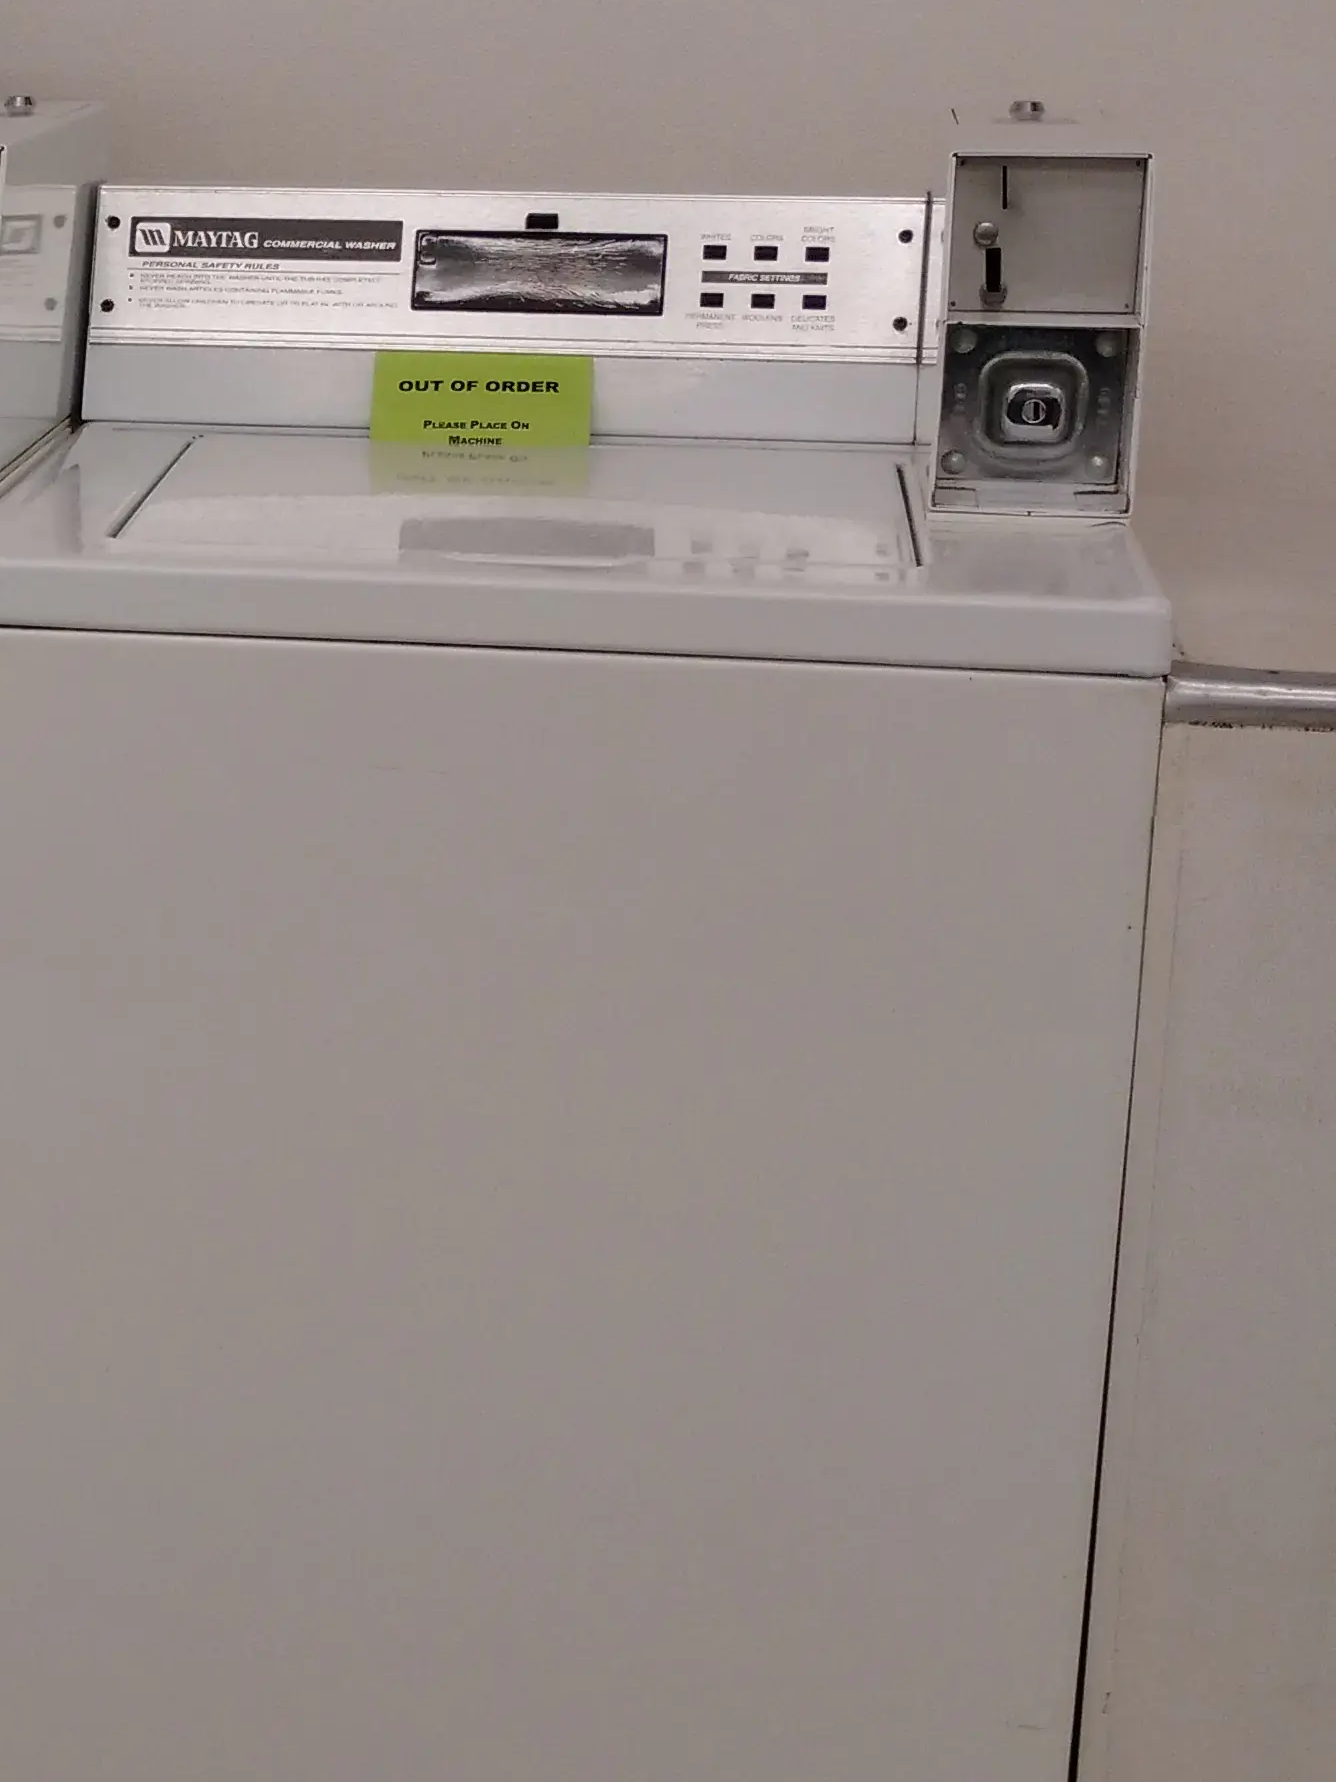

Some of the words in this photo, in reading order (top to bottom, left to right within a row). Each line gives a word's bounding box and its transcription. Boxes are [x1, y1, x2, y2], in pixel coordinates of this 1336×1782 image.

[172, 230, 259, 248] MAYTAG
[263, 239, 342, 249] COMMERCIAL
[345, 241, 396, 250] WASHER
[141, 260, 198, 268] PERSONAL
[200, 261, 242, 269] SAFETY
[243, 262, 280, 270] RULES
[728, 273, 758, 282] FABRIC
[759, 274, 801, 283] SETTINGS
[398, 380, 444, 392] OUT
[450, 380, 478, 392] OF
[485, 380, 560, 393] ORDER
